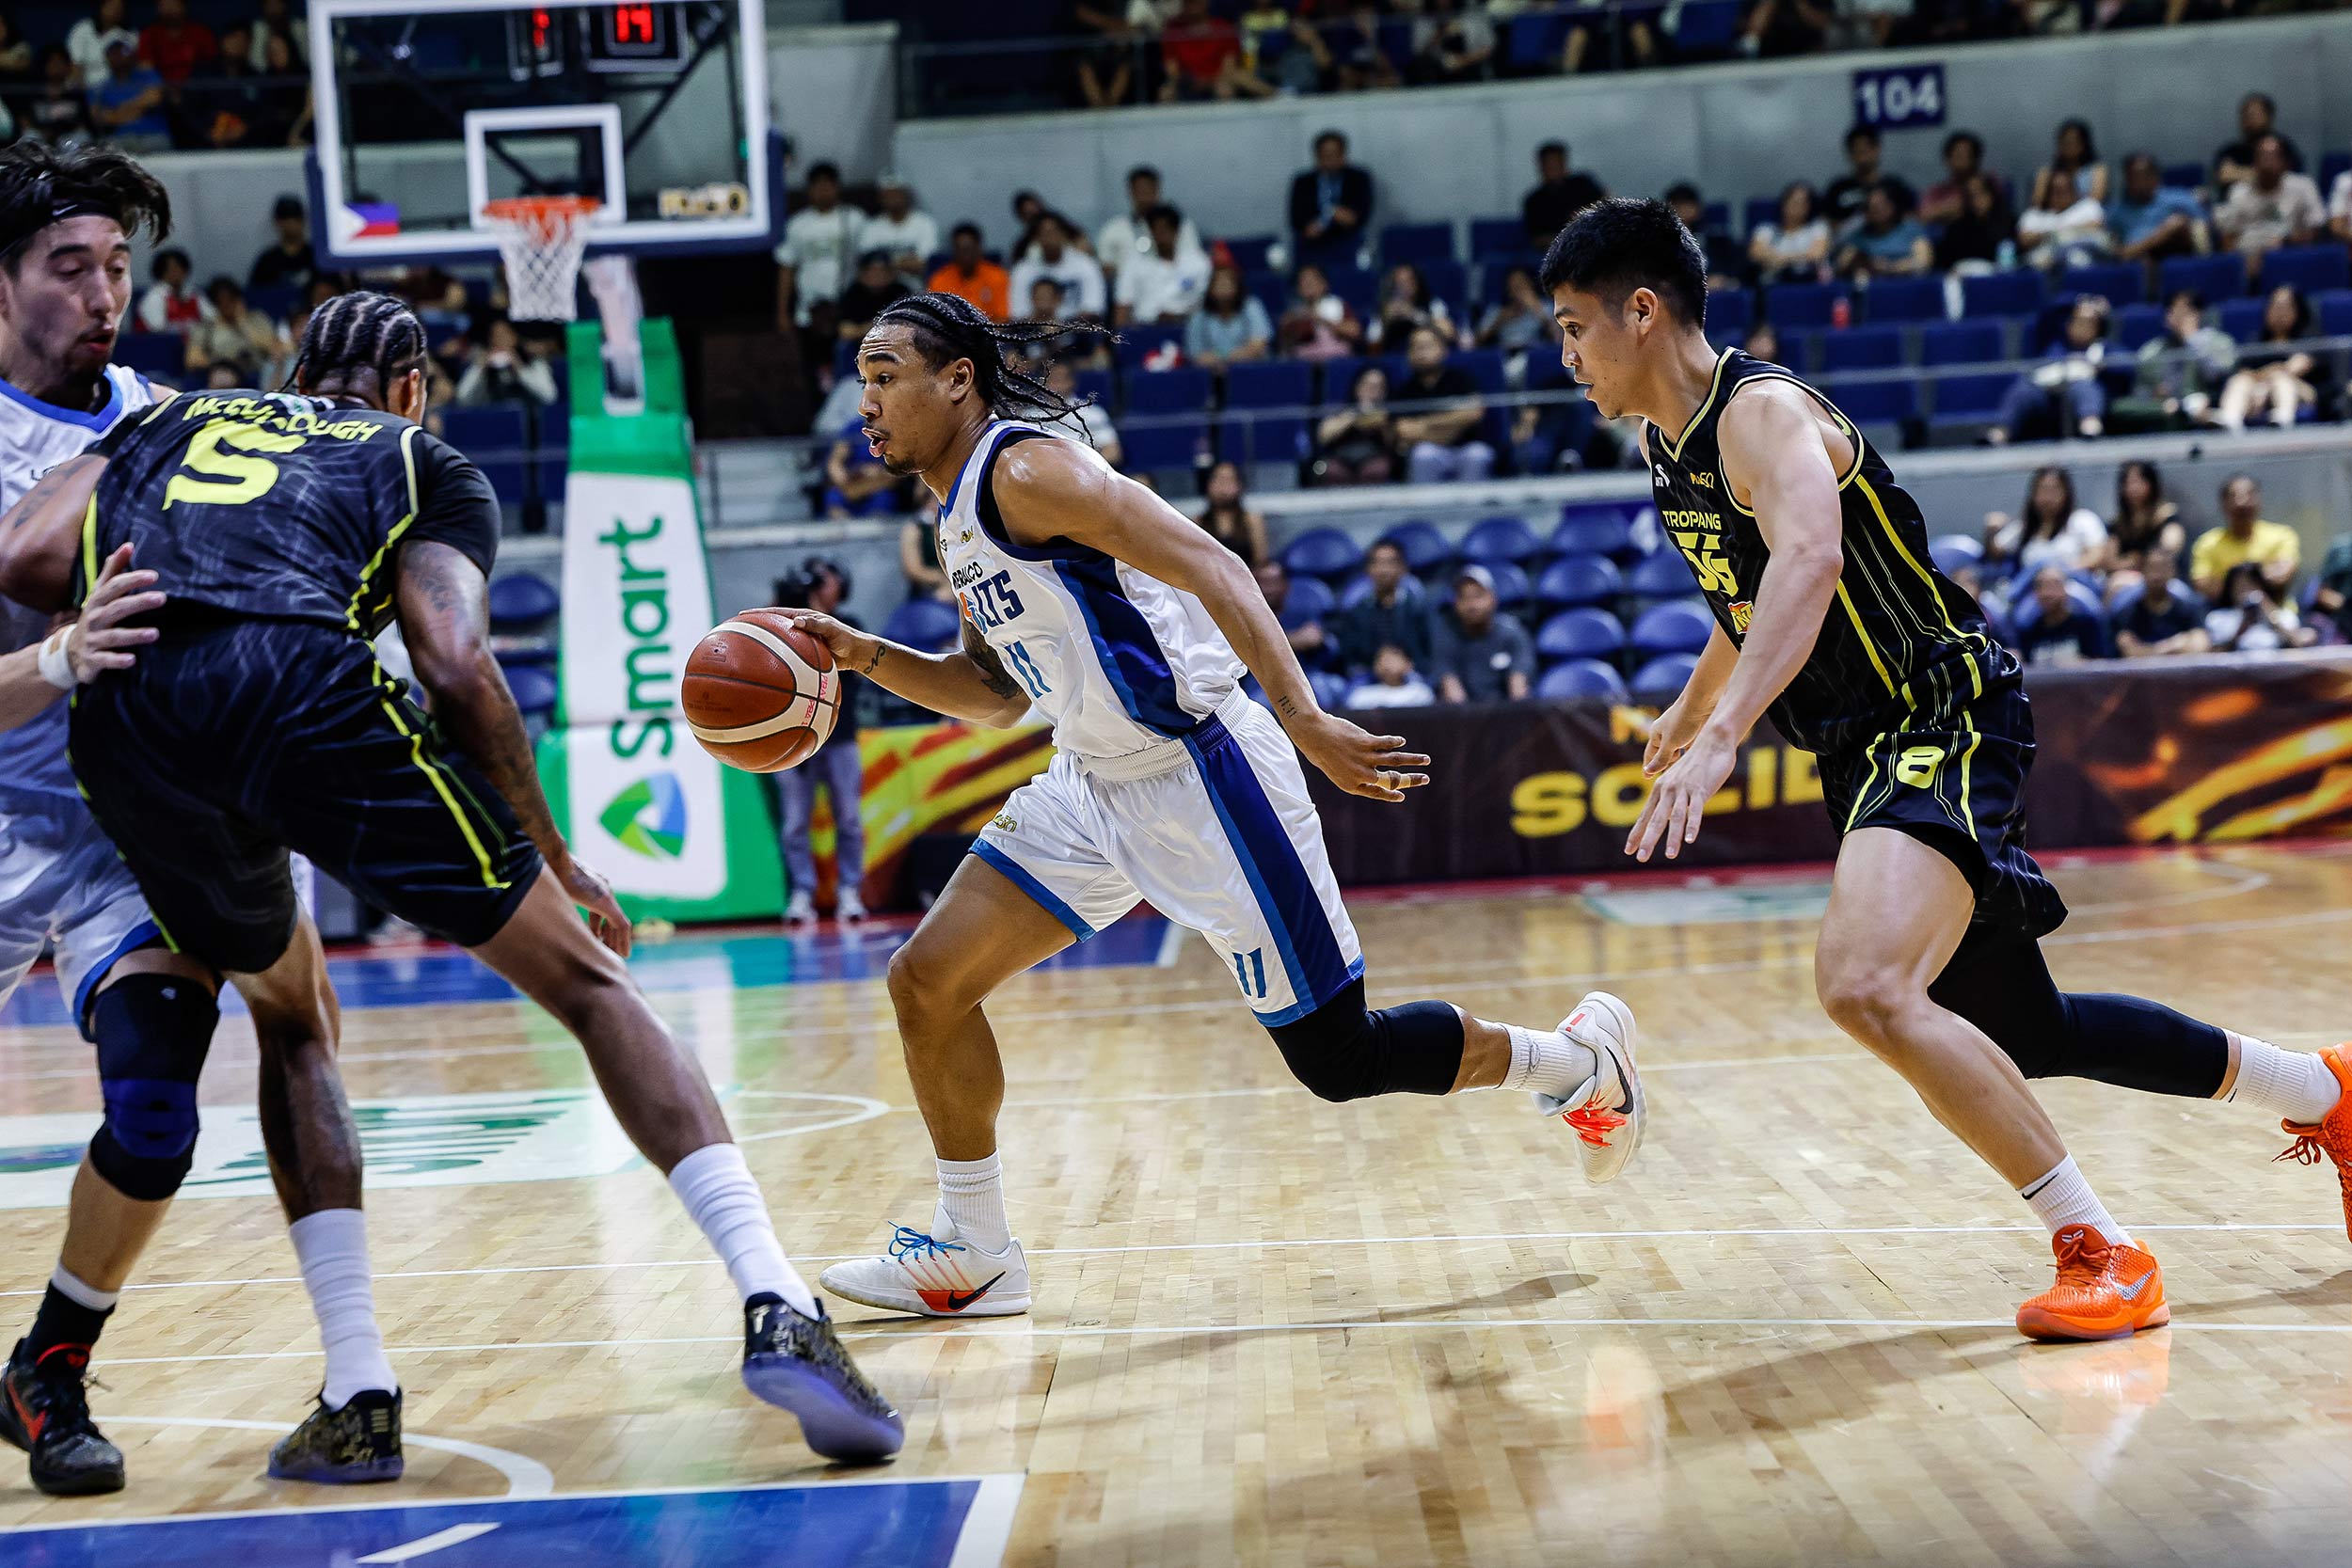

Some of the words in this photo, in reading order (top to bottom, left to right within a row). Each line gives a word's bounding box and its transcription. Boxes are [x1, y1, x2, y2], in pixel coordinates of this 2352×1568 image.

[1858, 74, 1940, 123] 104
[162, 417, 309, 512] 5
[1661, 510, 1723, 531] TROPANG
[598, 515, 675, 758] Smart
[1896, 746, 1946, 789] 8
[1232, 946, 1267, 999] 11
